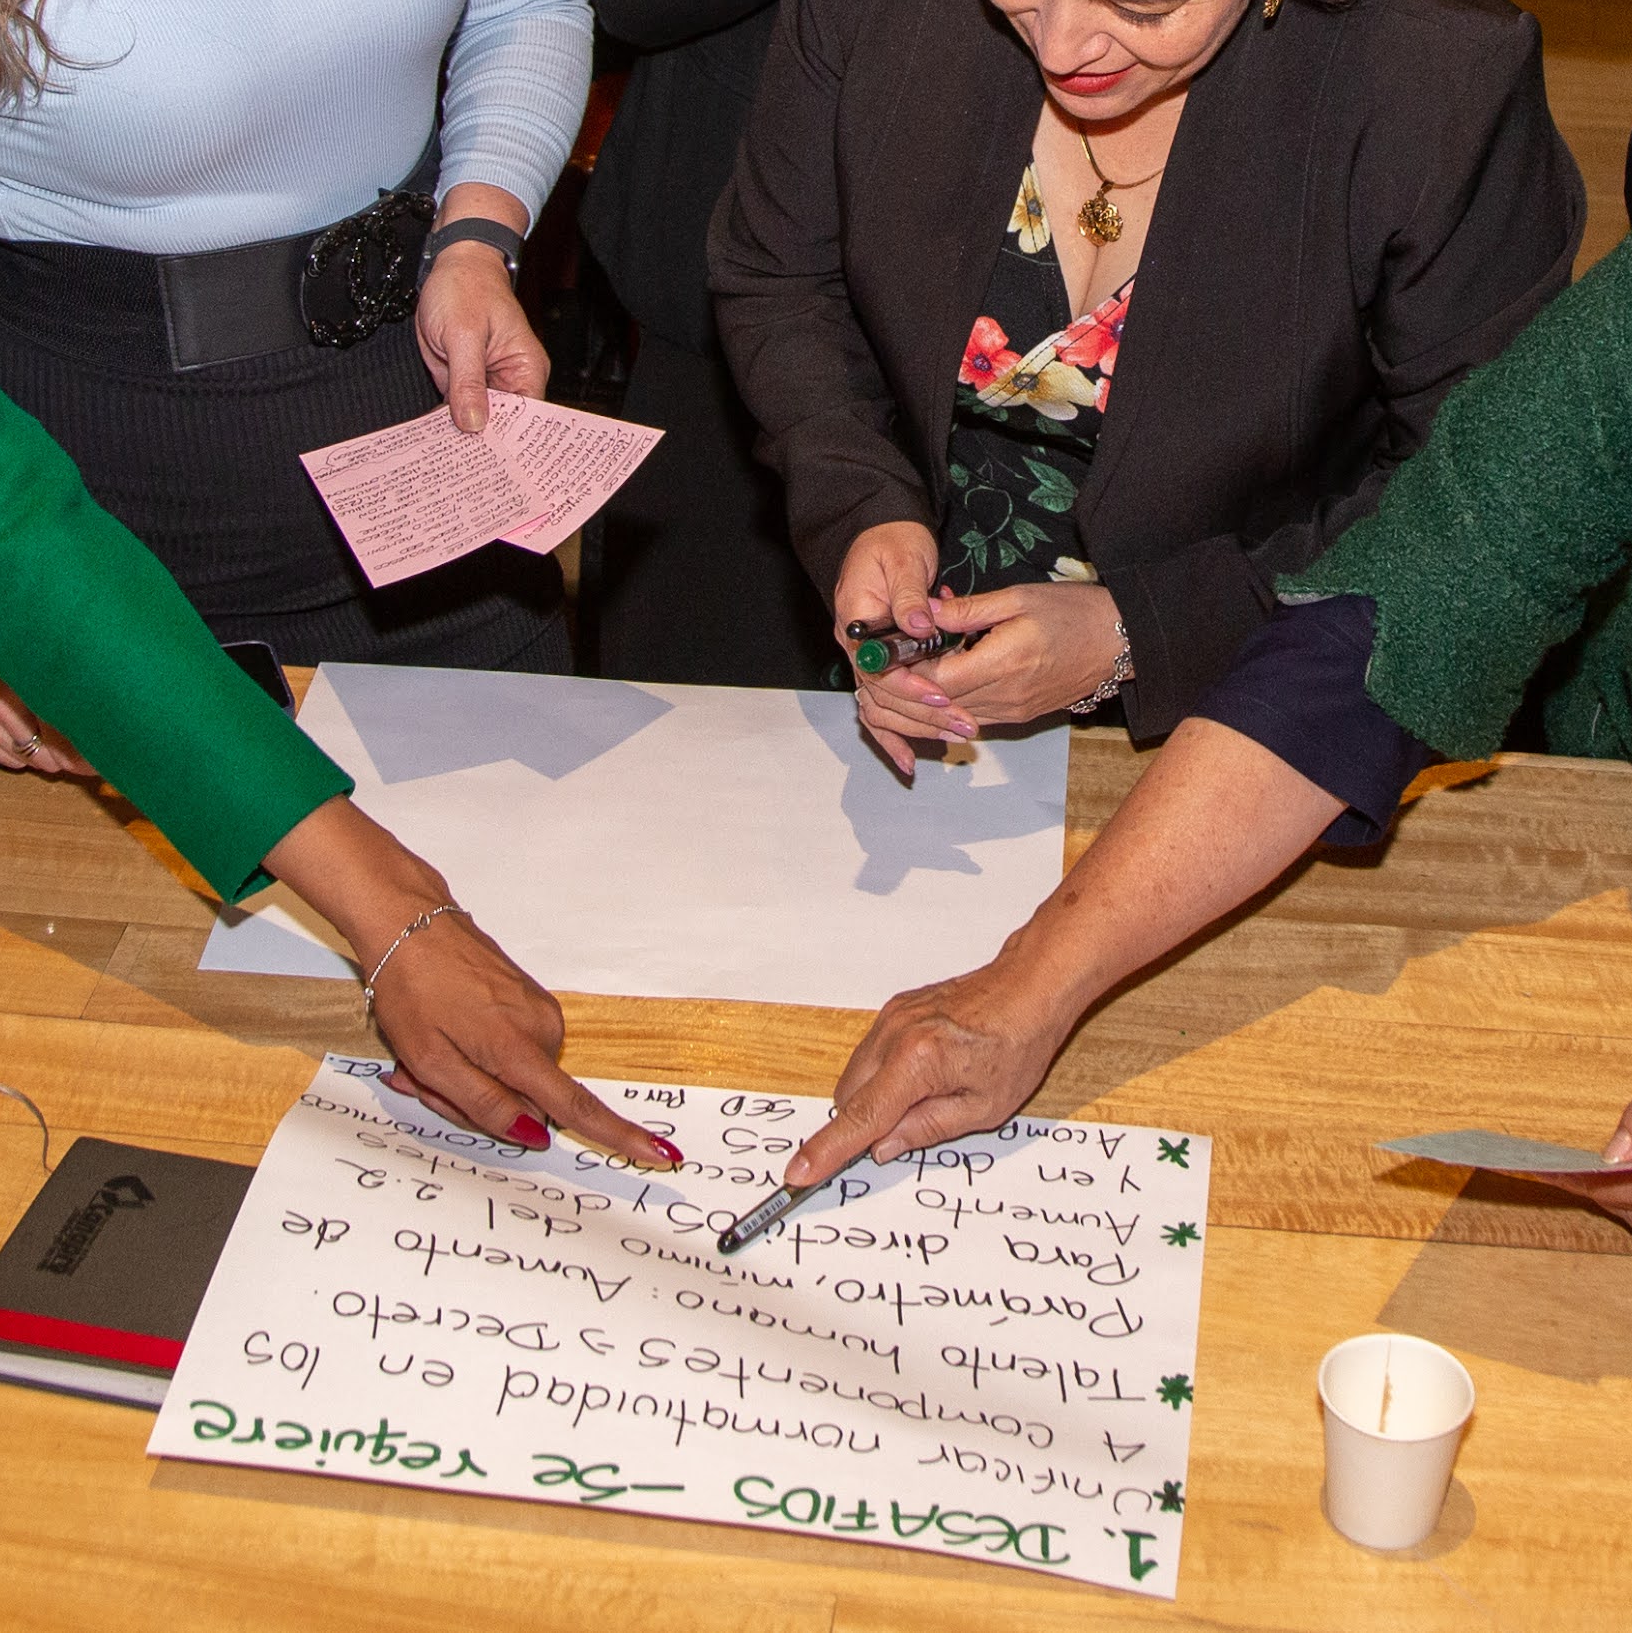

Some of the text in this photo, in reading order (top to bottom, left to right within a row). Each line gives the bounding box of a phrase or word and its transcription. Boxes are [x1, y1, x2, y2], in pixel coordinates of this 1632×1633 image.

[531, 442, 576, 485] AUTONOM
[537, 429, 597, 492] INSTITUCIONA
[719, 1095, 796, 1123] SED
[334, 1158, 444, 1202] 2.2
[356, 1130, 612, 1216] docentes
[1037, 1165, 1095, 1188] en
[281, 1210, 351, 1251] de
[485, 1197, 583, 1239] del
[914, 1188, 1141, 1247] Aumento
[394, 1230, 632, 1303] Aumento
[1003, 1234, 1140, 1287] Para
[940, 1345, 1147, 1404] Talento
[188, 1400, 488, 1480] requiere
[243, 1330, 1154, 1516] Unificar normatividad en los
[1103, 1526, 1159, 1582] 1.
